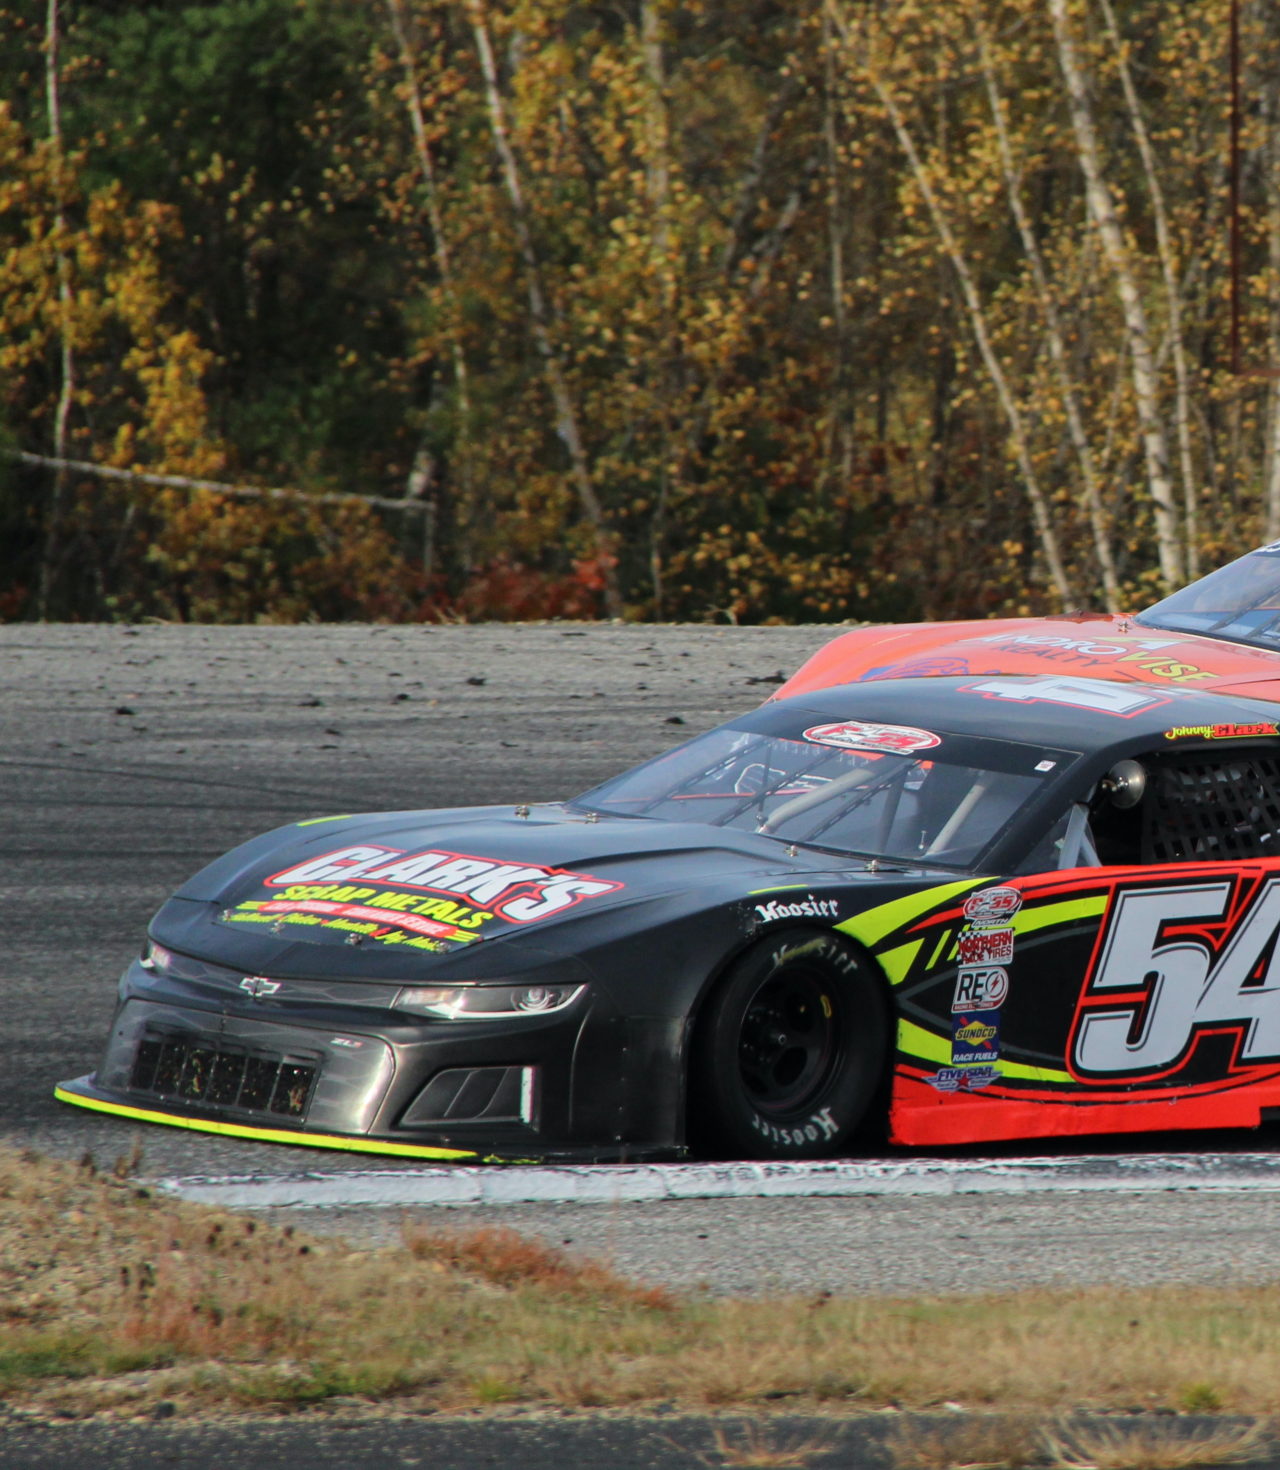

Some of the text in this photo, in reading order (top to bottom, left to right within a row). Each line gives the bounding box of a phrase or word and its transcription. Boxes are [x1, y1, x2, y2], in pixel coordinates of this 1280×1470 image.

[1164, 725, 1214, 740] Johnny
[271, 845, 615, 921] CLARK'S
[272, 884, 377, 907] SCRAP
[362, 891, 496, 930] METALS
[754, 893, 841, 924] Hoosier
[958, 930, 1013, 952] NORTHERN
[956, 1027, 996, 1040] SUNOCO
[952, 1051, 998, 1063] RACE FUELS
[938, 1069, 963, 1081] FIVE
